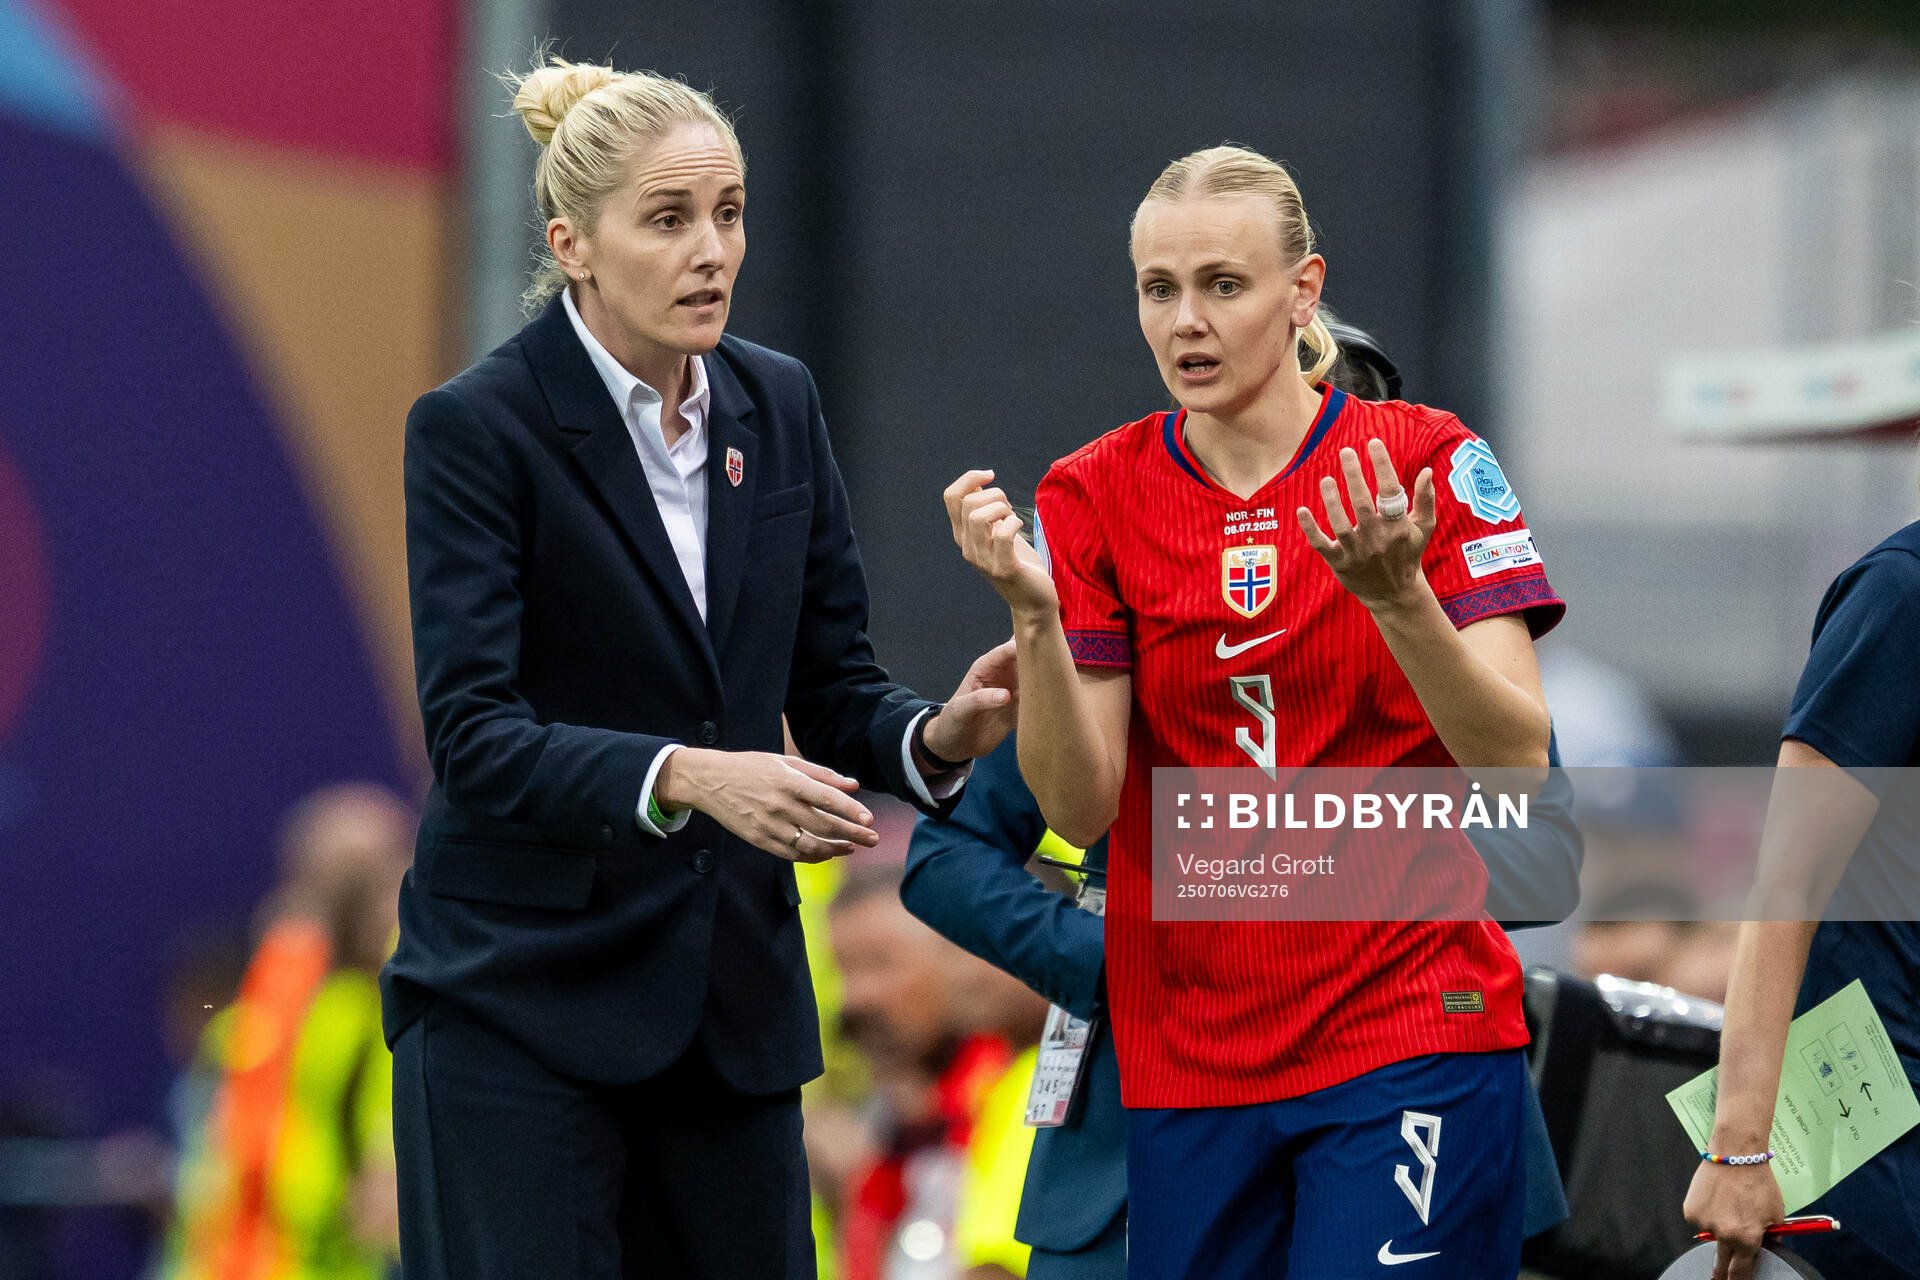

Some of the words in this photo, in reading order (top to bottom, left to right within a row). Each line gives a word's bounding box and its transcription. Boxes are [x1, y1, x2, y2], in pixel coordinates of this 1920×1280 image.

[1472, 467, 1485, 475] We
[1477, 477, 1494, 486] Play
[1480, 485, 1505, 494] Strong
[1226, 511, 1248, 523] NOR
[1256, 508, 1275, 519] FIN
[1465, 542, 1483, 553] UEFA
[1468, 543, 1529, 564] FOUNDATION
[1229, 674, 1276, 782] 9
[1782, 1093, 1799, 1116] TEAM
[1871, 1106, 1881, 1116] IN
[1795, 1114, 1811, 1136] HOME
[1848, 1124, 1862, 1141] OUT
[1394, 1110, 1442, 1226] 9
